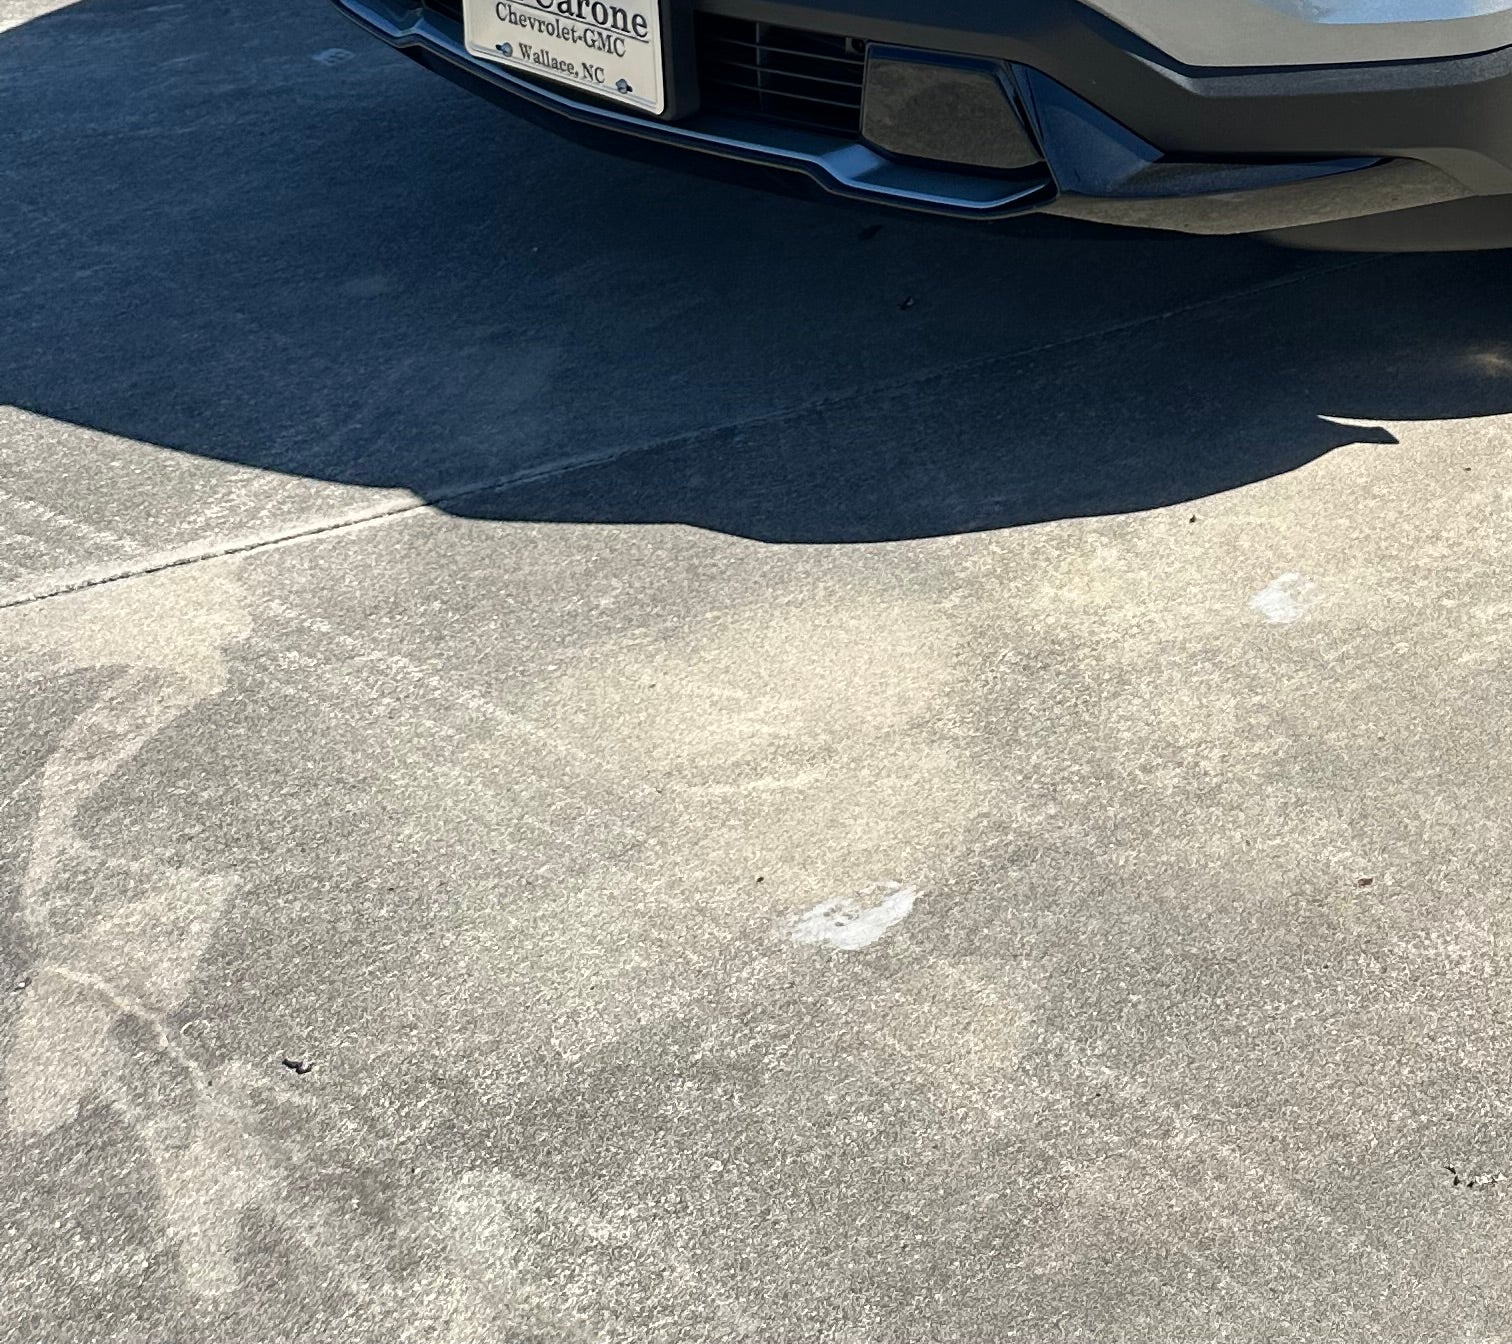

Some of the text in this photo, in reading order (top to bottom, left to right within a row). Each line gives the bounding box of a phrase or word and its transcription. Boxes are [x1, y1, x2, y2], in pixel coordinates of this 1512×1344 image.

[496, 1, 626, 58] Chevrolet-GMC
[518, 42, 606, 84] Wallace, NC
